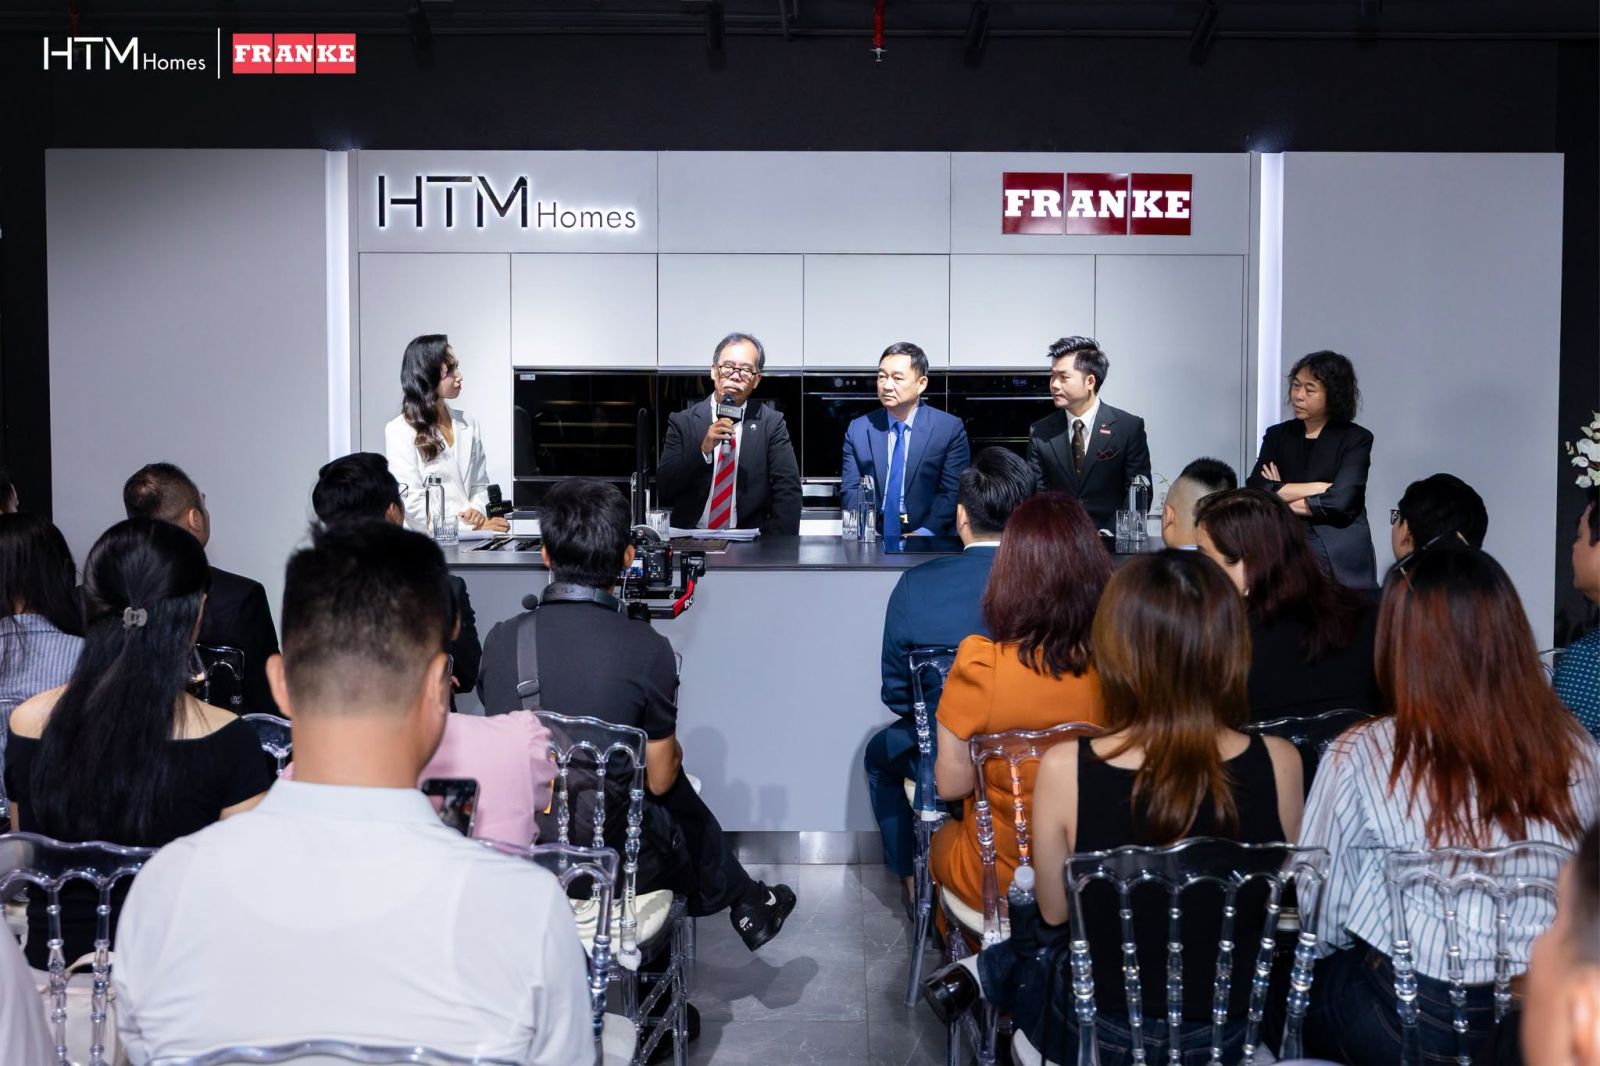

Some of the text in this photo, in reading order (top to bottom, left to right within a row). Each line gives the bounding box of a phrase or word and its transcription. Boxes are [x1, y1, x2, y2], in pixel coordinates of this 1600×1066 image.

[378, 175, 637, 229] HTM Homes
[1004, 189, 1191, 219] FRANKE
